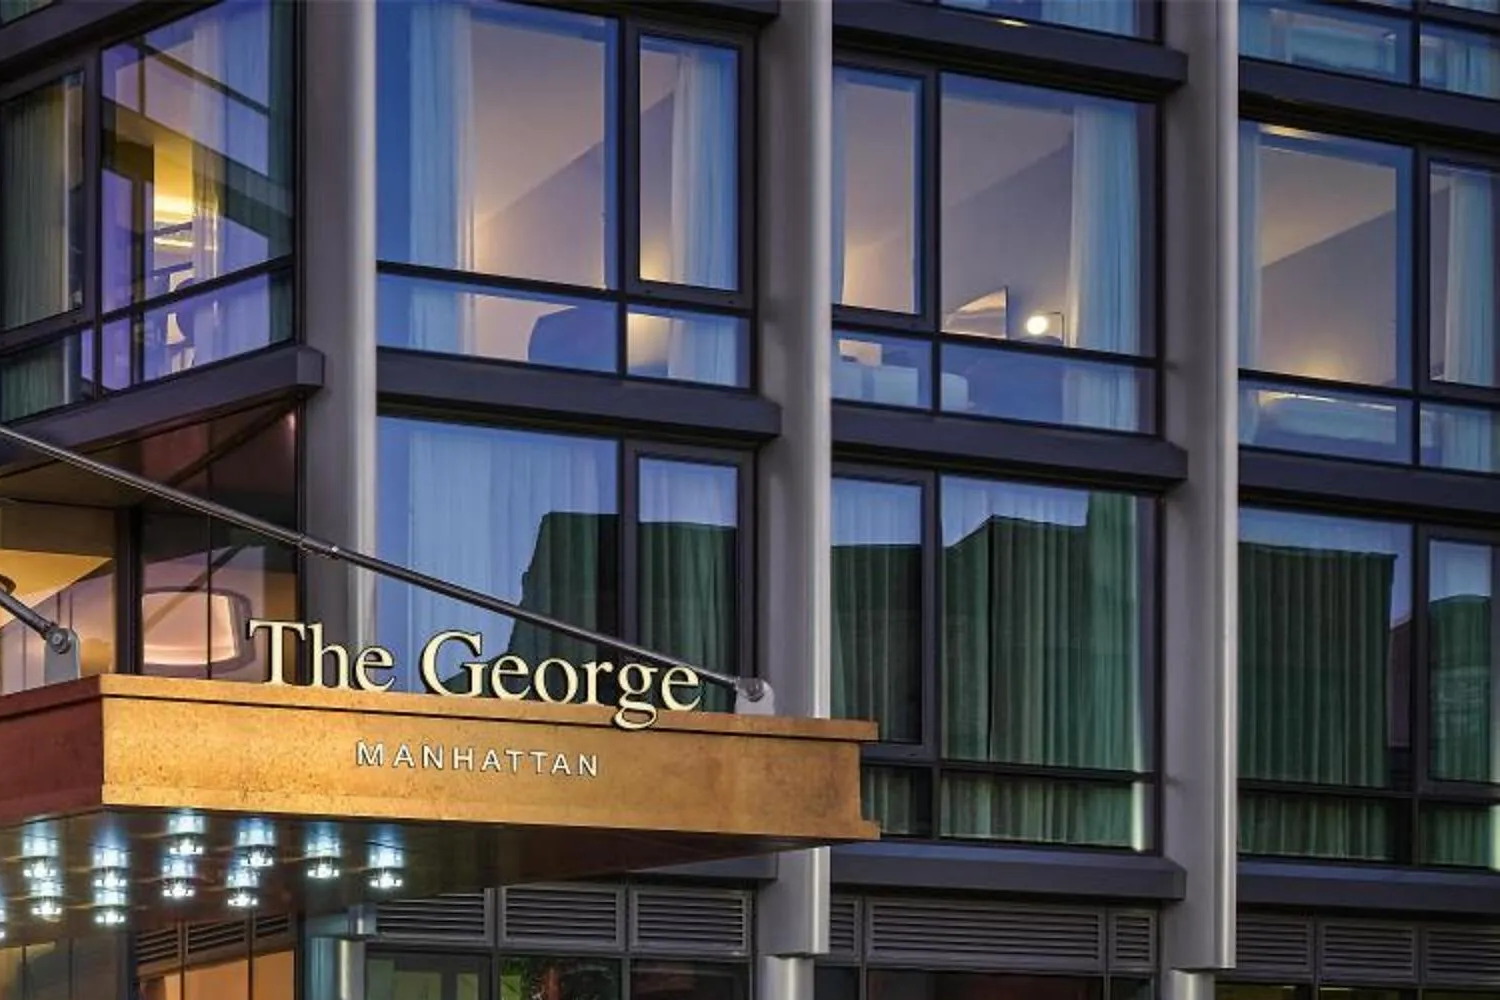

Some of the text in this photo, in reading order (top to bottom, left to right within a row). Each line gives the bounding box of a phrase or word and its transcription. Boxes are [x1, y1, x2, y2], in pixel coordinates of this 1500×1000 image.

[249, 620, 701, 728] The George
[355, 740, 598, 776] MANHATTAN
